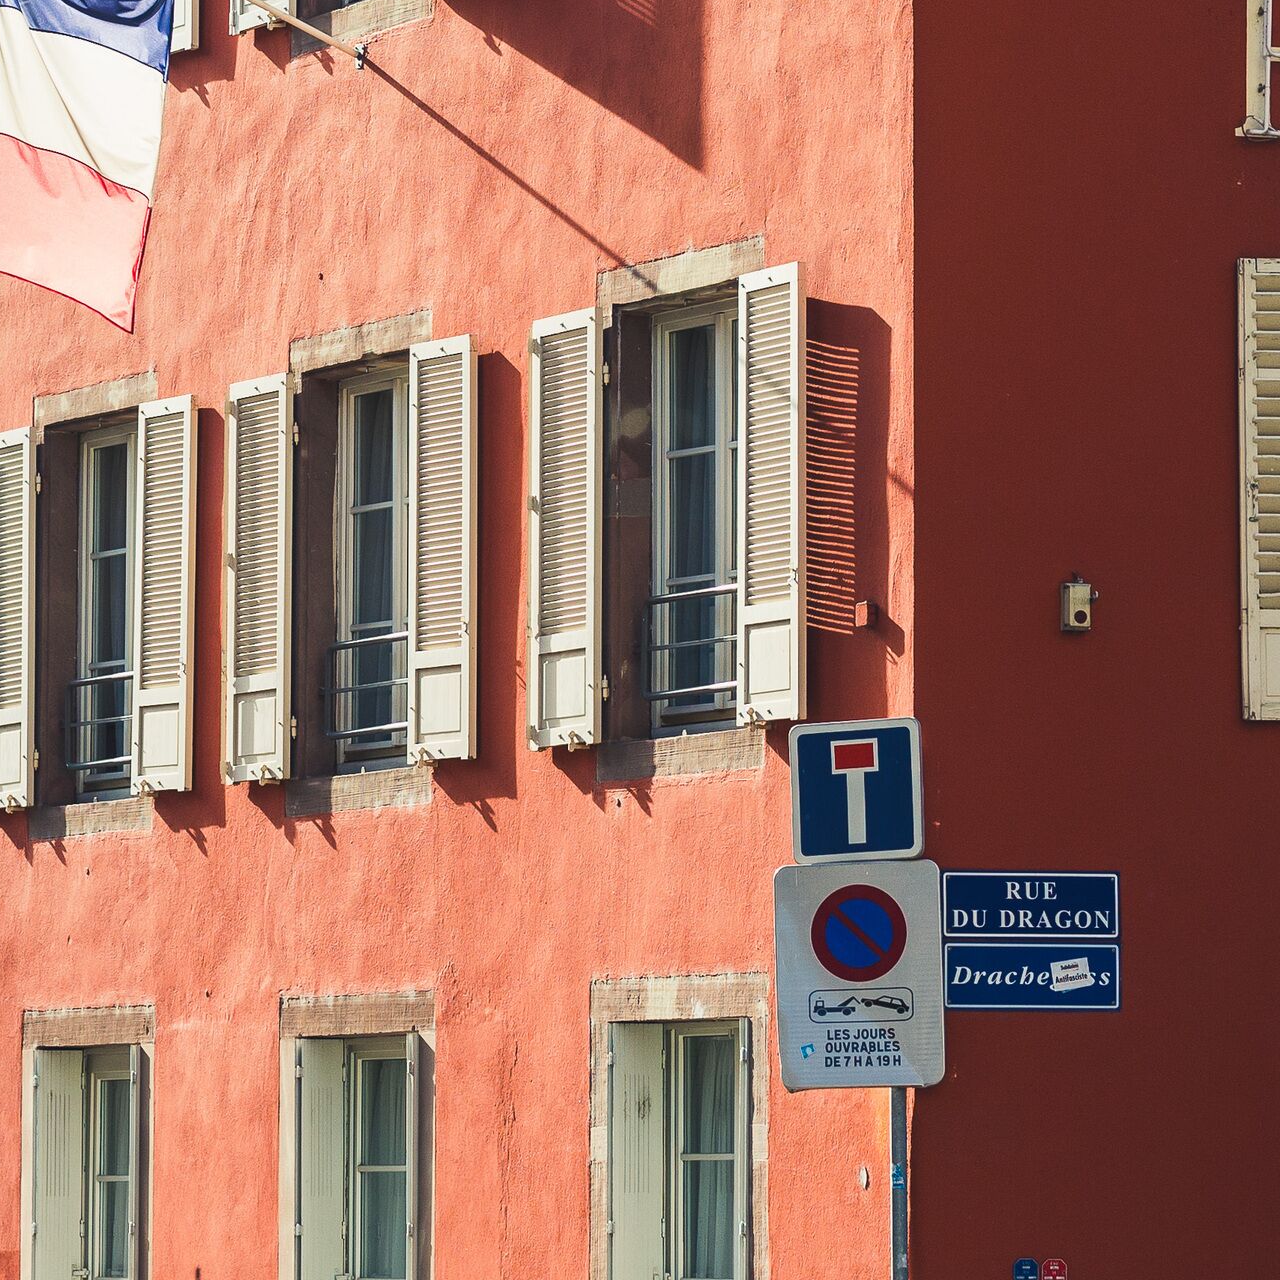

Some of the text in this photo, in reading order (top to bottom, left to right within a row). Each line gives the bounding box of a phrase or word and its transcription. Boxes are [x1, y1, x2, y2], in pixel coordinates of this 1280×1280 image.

[1005, 881, 1058, 900] RUE
[951, 909, 1111, 929] DU DRAGON
[1055, 972, 1088, 984] Antifasciste
[827, 1028, 896, 1040] LES JOURS
[825, 1041, 901, 1053] OUVRABLES
[824, 1056, 841, 1068] DE
